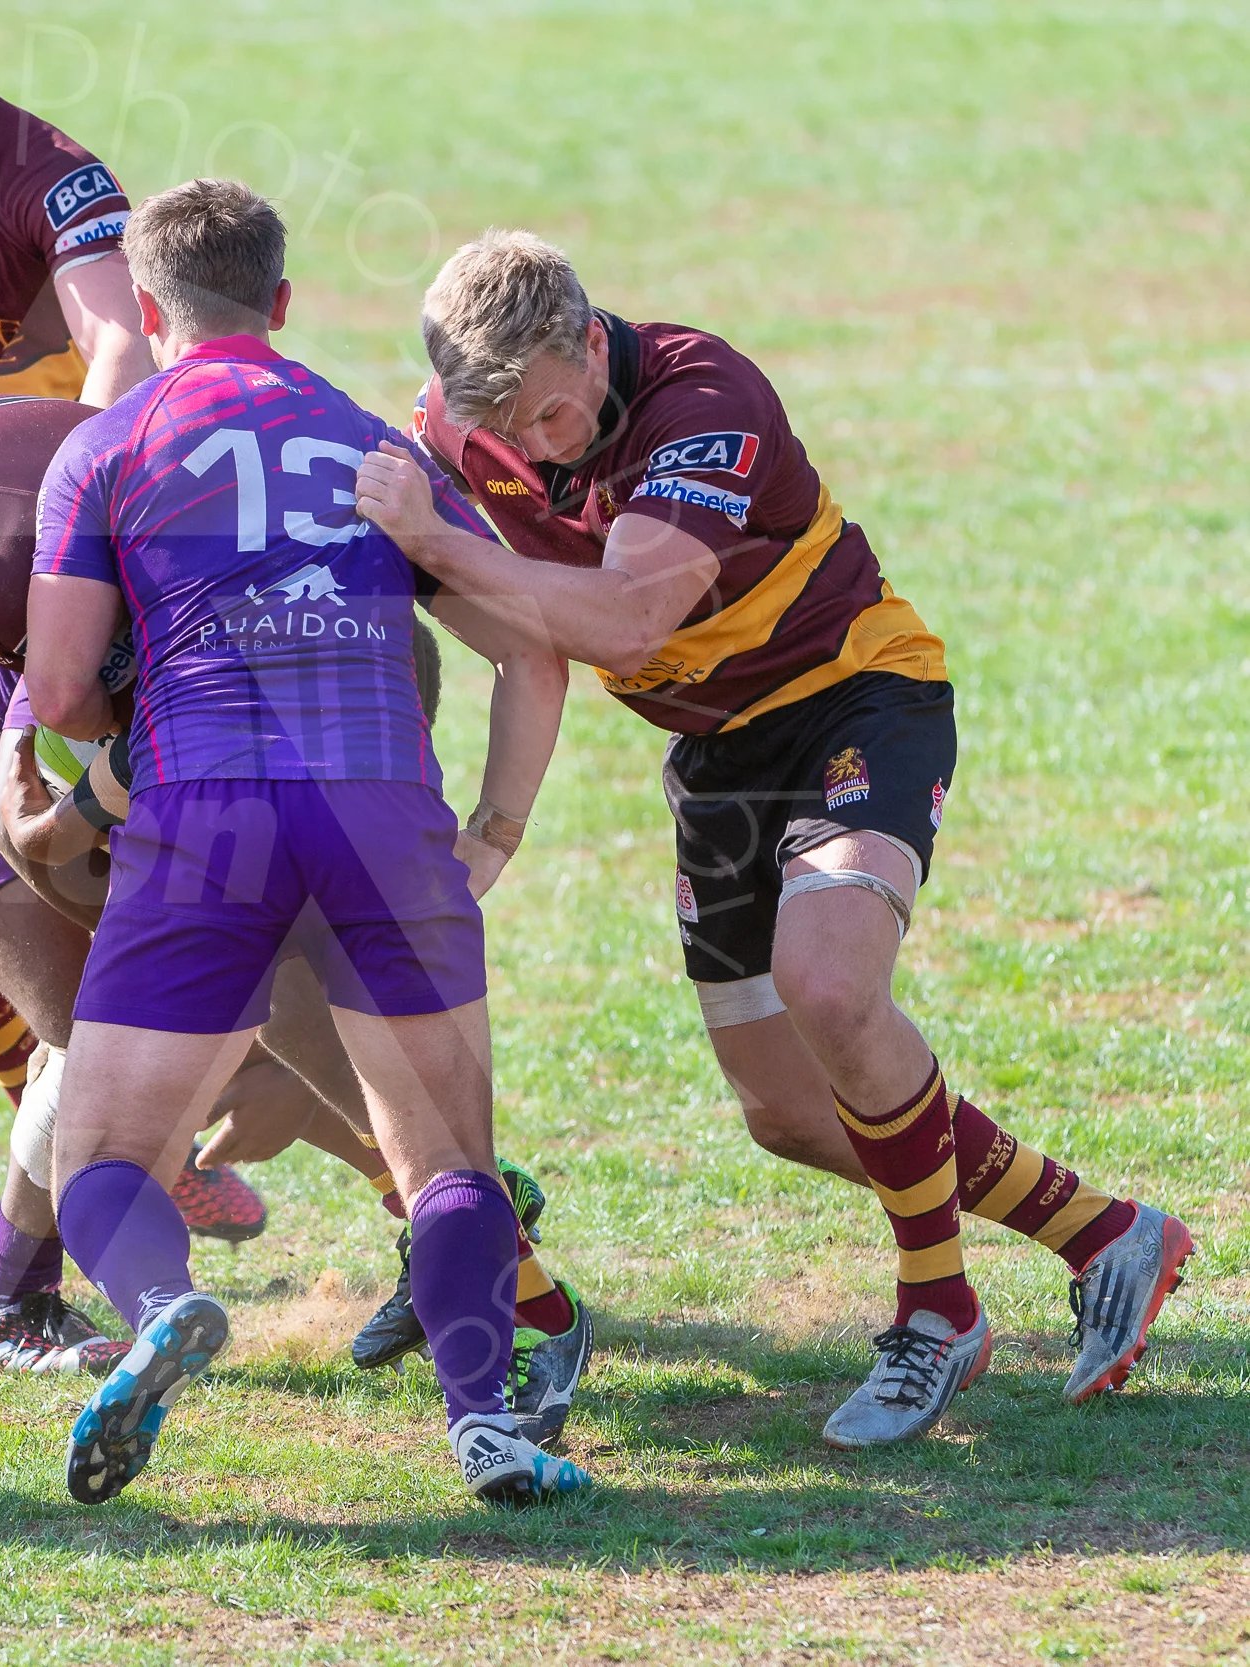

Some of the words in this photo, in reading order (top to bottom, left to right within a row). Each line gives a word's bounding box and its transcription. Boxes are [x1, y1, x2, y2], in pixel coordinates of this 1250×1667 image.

[55, 170, 113, 216] BCA
[181, 428, 372, 553] 13
[826, 777, 868, 798] AMPTHILL
[828, 789, 870, 812] RUGBY
[465, 1451, 515, 1485] adidas
